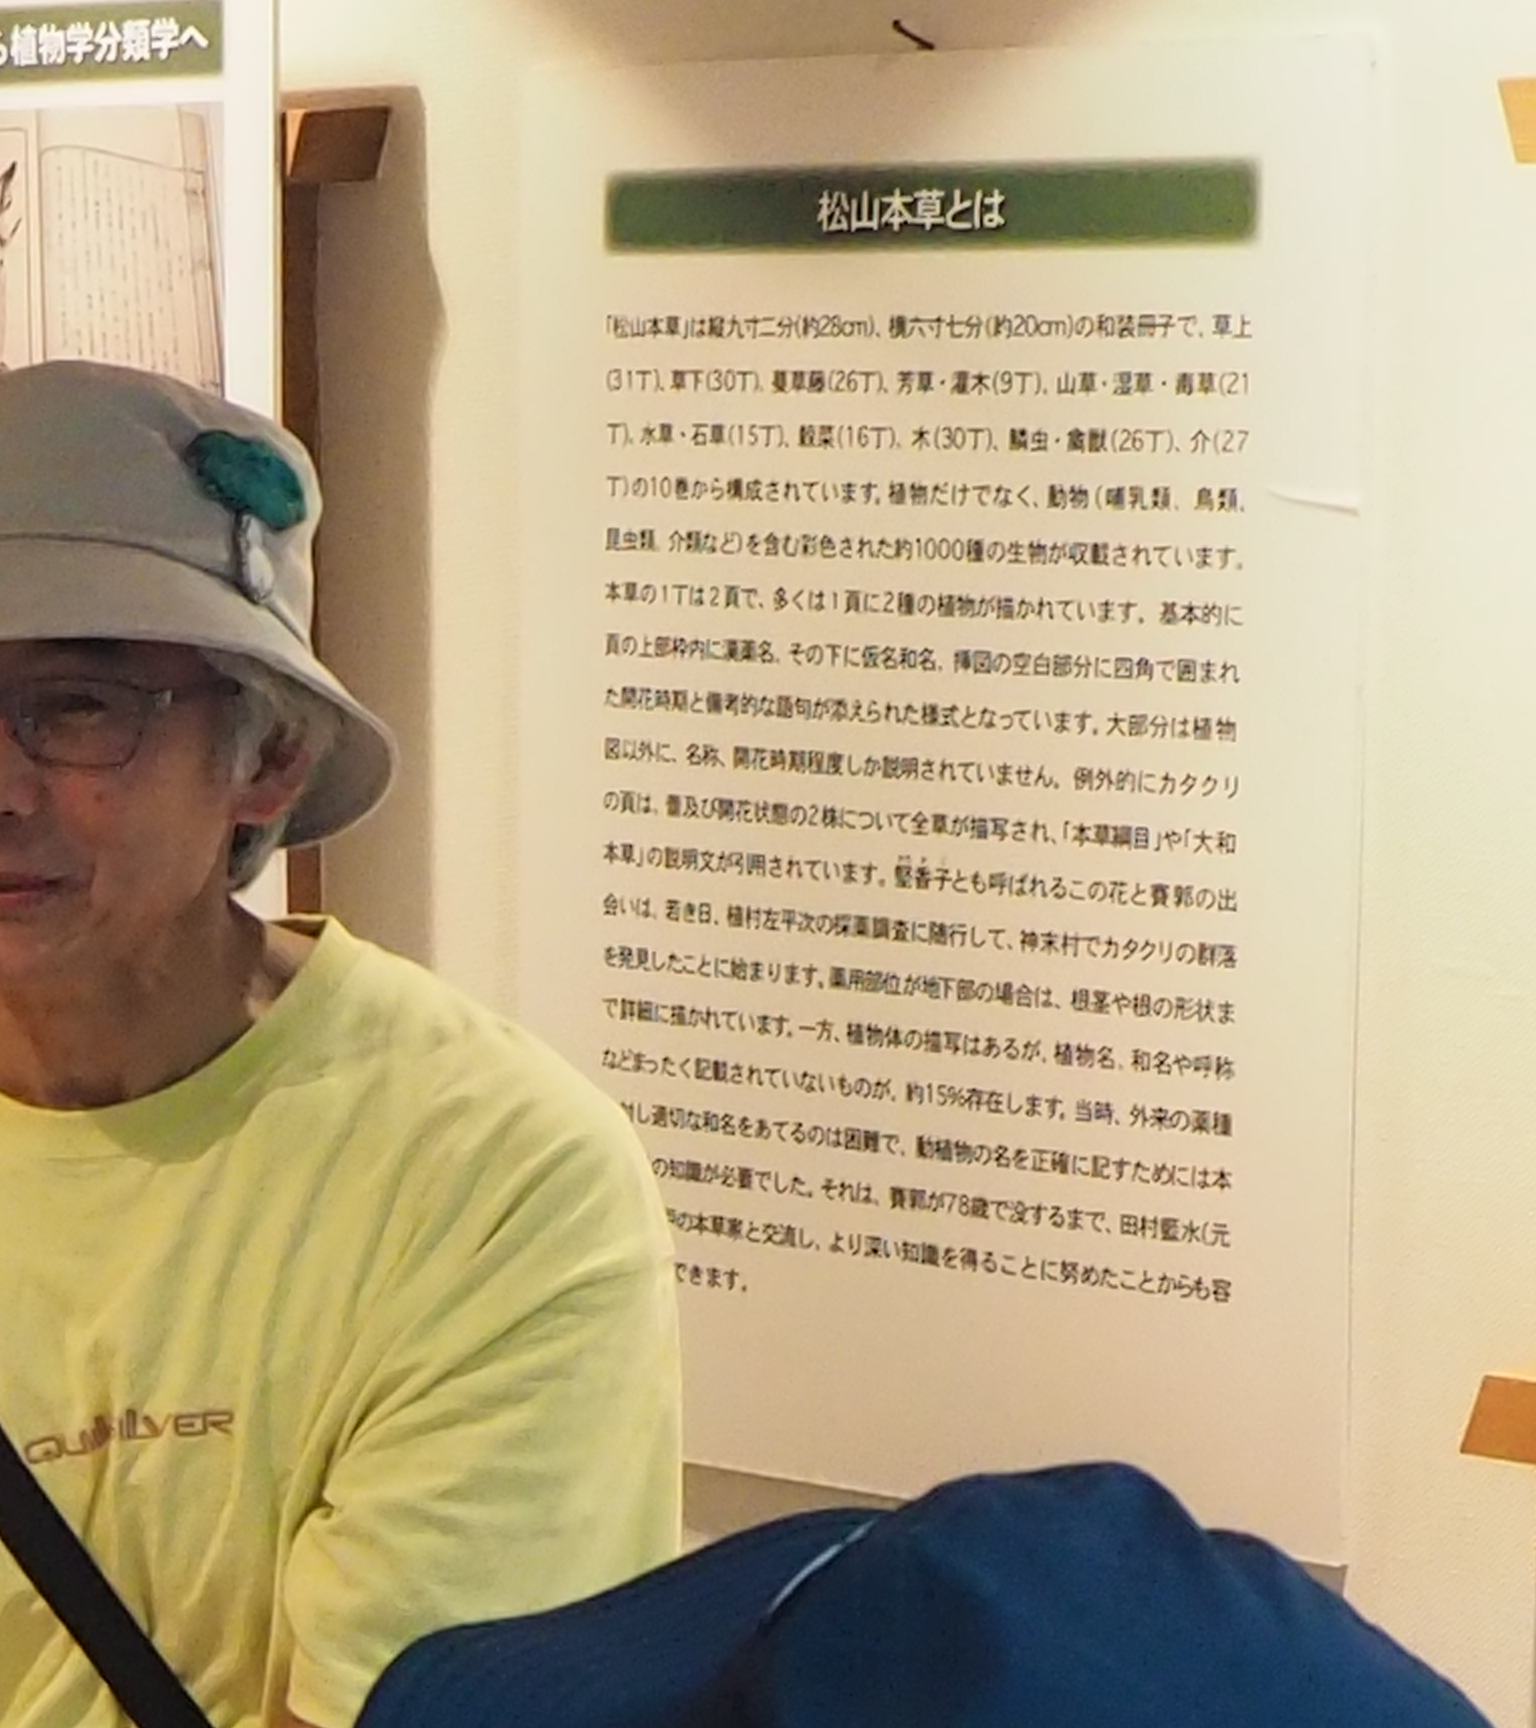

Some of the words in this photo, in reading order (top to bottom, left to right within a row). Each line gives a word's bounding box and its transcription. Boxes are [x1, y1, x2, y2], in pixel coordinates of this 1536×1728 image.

[815, 186, 1007, 233] 松山本草とは
